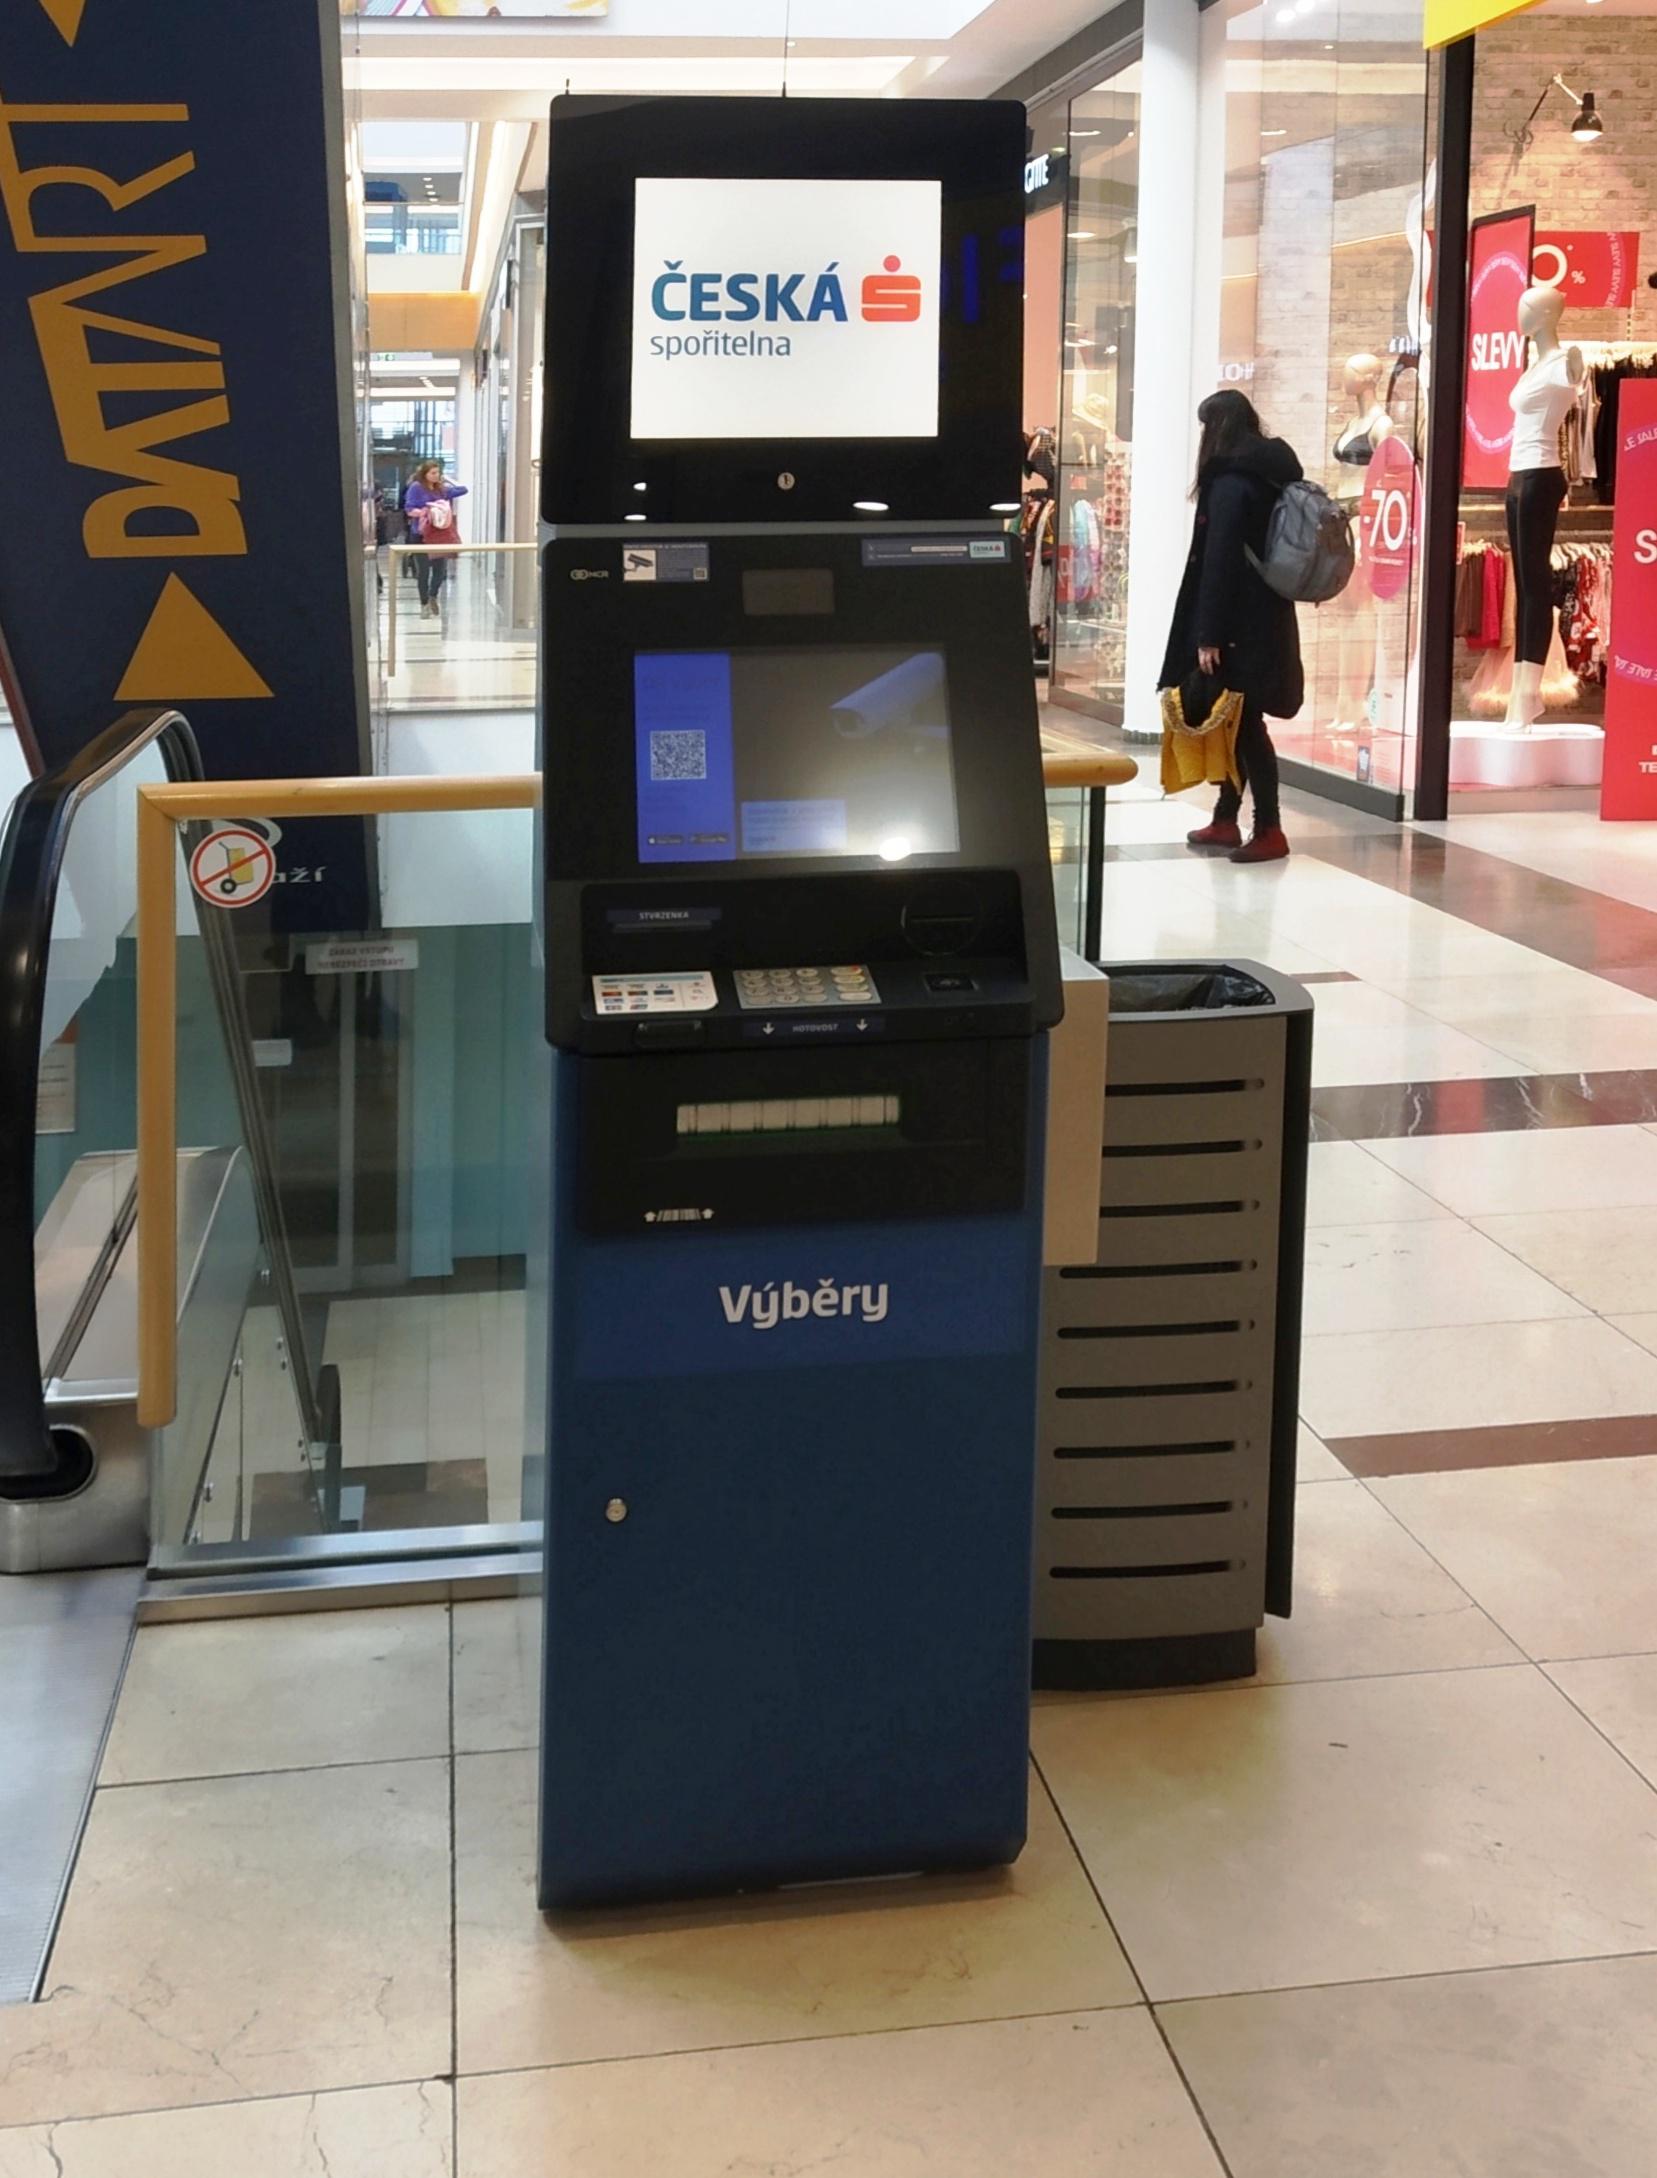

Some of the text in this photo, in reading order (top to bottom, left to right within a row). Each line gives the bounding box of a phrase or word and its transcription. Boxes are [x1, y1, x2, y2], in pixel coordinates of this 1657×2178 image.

[651, 259, 849, 322] ČESKÁ
[0, 91, 247, 558] DATART
[650, 330, 791, 360] spořitelna
[1472, 331, 1525, 371] SLEVY
[639, 911, 689, 920] STVRZENKA
[792, 1023, 838, 1033] HOTOVOST
[719, 1277, 888, 1329] Výběry
